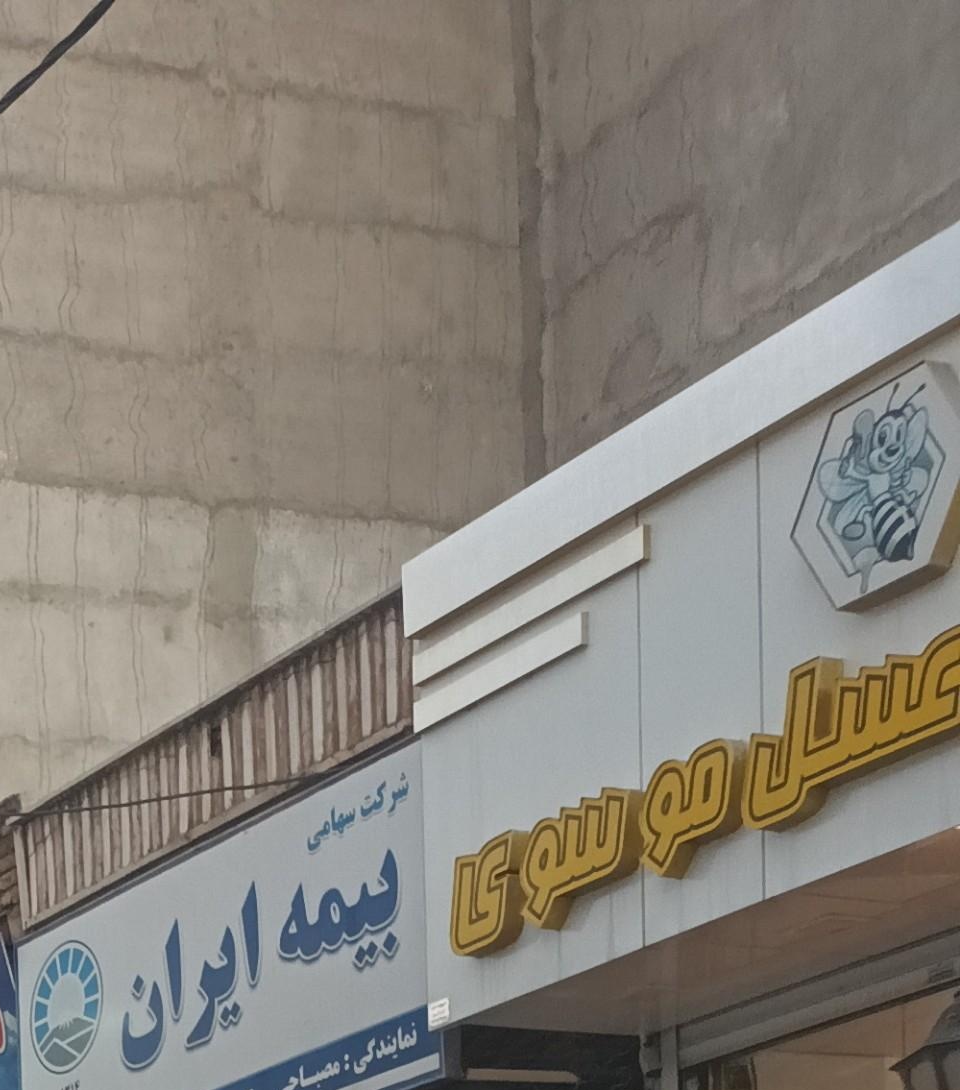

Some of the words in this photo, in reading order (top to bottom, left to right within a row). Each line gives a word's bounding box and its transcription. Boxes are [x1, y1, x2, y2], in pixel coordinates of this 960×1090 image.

[740, 620, 960, 832] عسل
[306, 805, 357, 853] سهامی
[360, 771, 410, 818] شرکت
[278, 847, 400, 969] بیمه
[118, 880, 260, 1072] ایران
